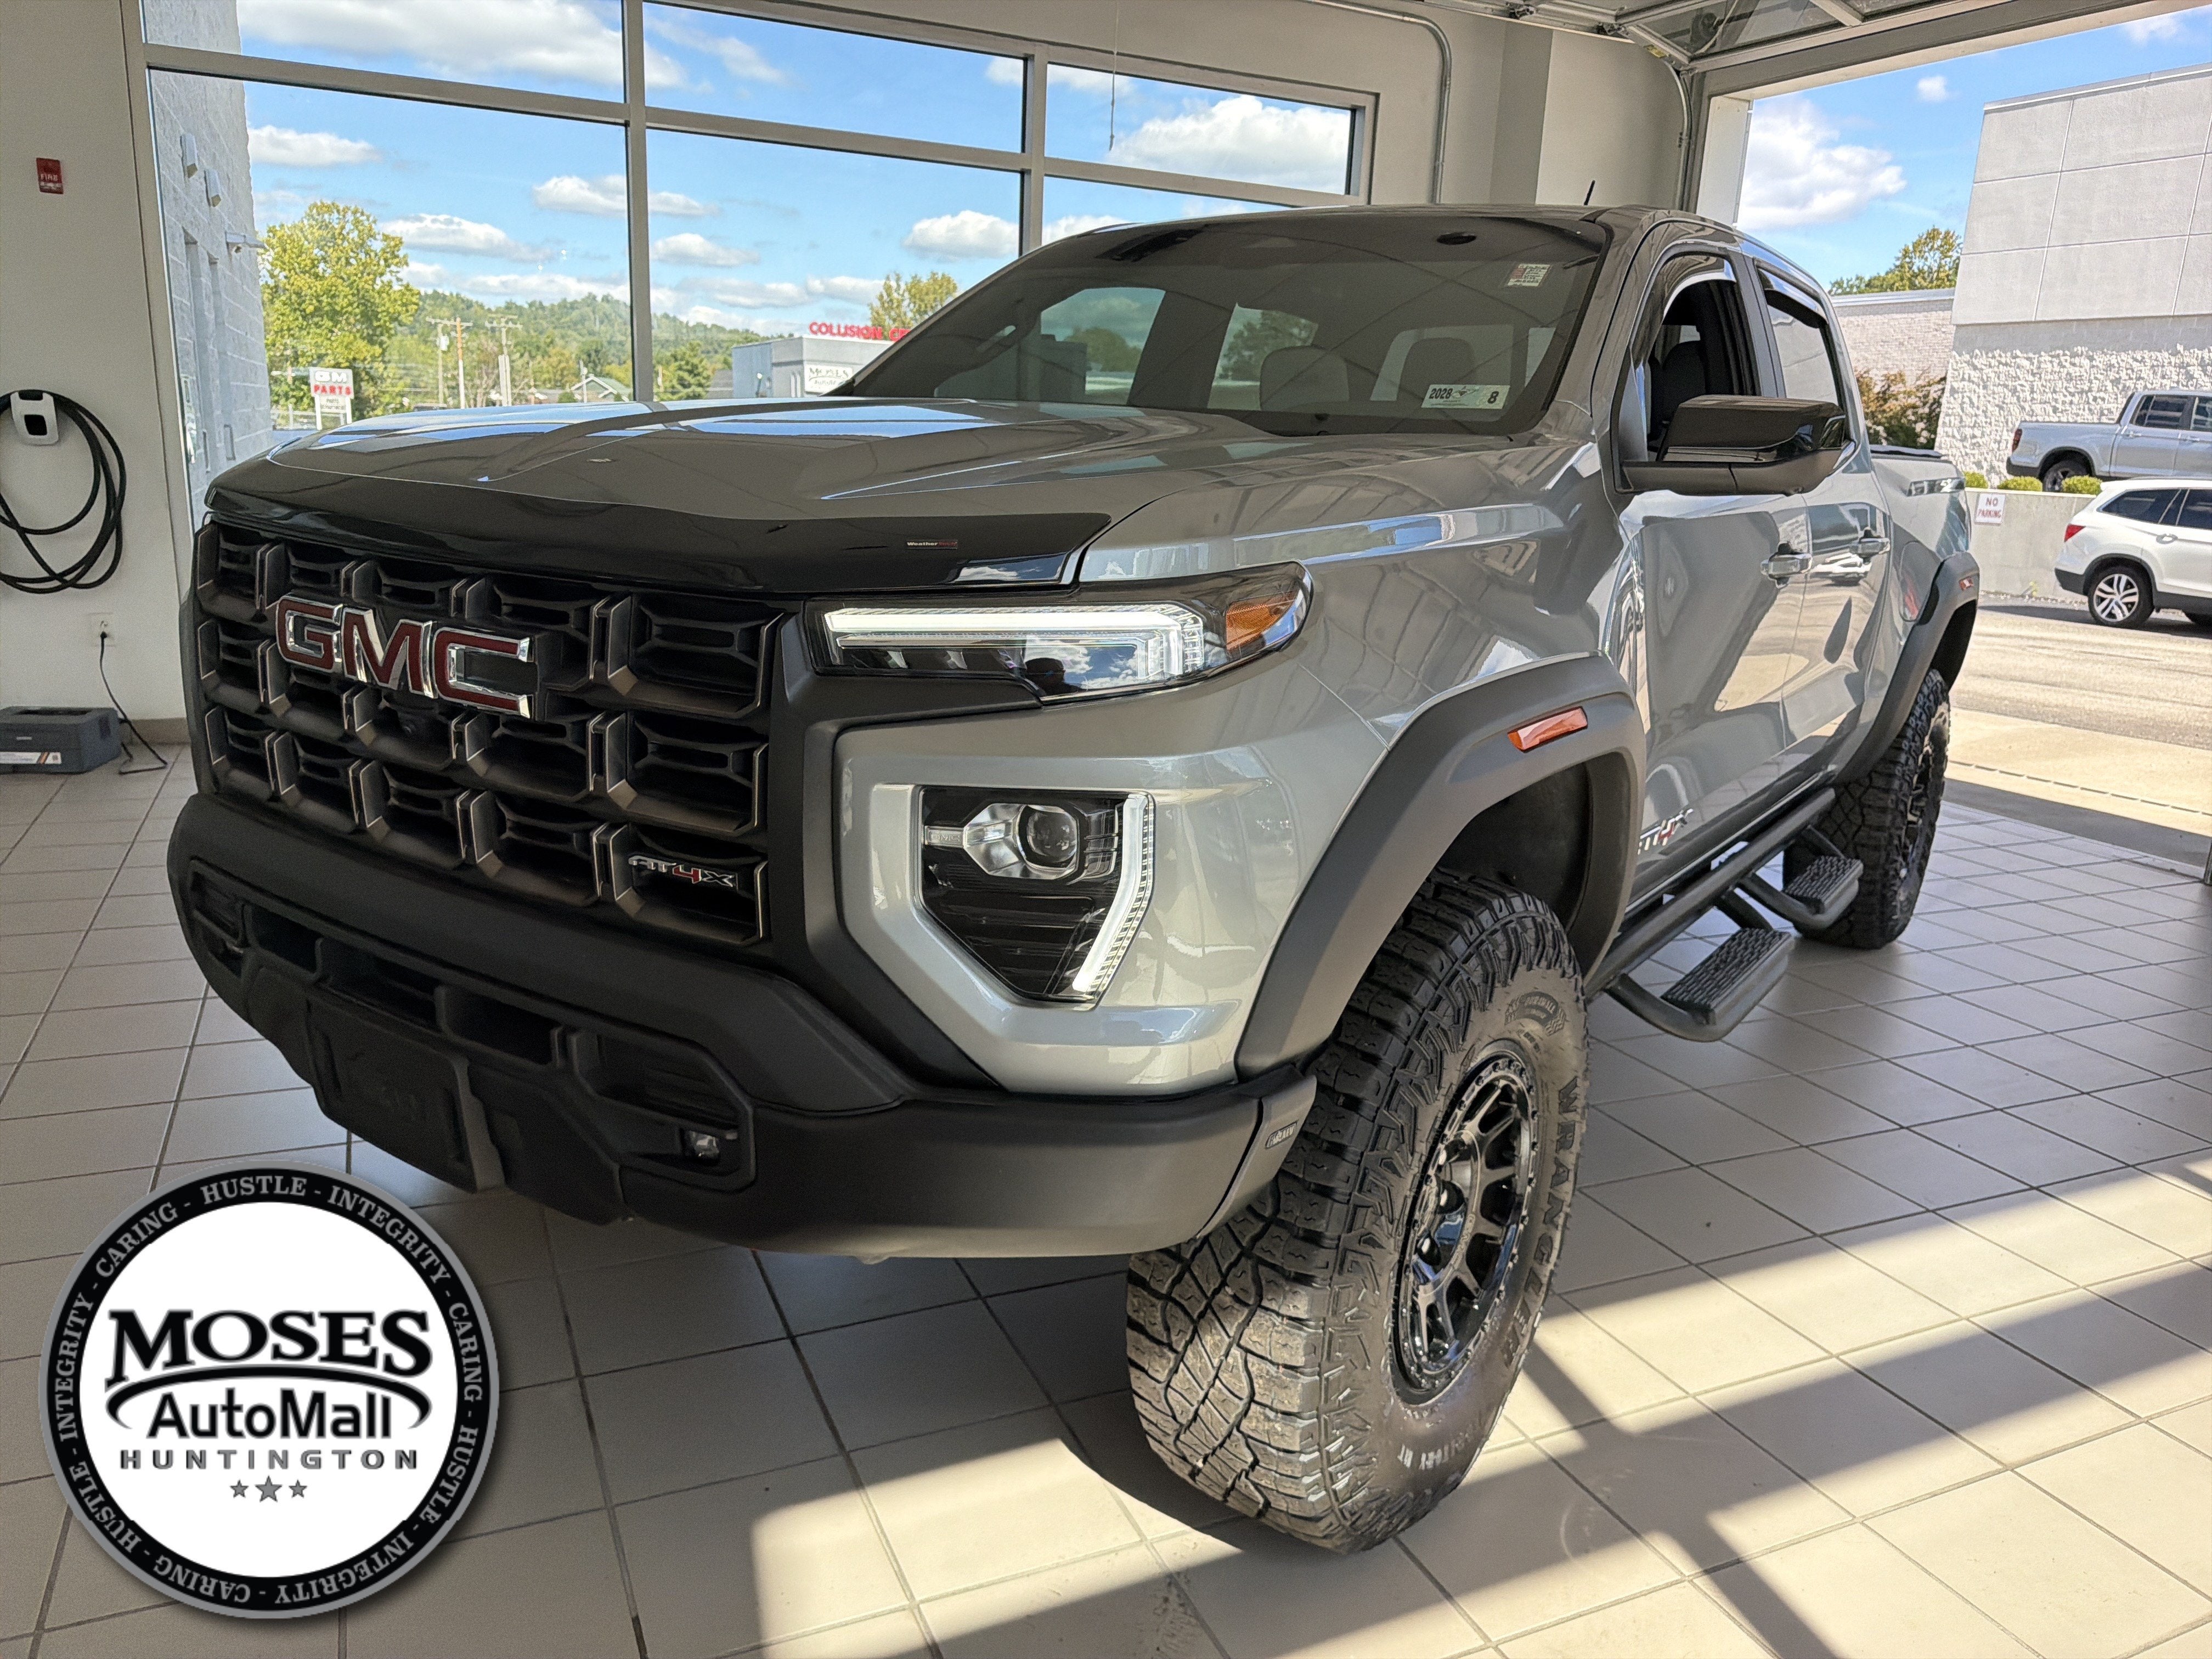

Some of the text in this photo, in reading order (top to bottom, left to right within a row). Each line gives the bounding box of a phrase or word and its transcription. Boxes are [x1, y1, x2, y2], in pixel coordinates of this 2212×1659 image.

[809, 321, 883, 340] COLLISION
[315, 371, 347, 382] GM
[314, 384, 352, 395] PARTS
[1429, 388, 1499, 404] 2028 8
[1985, 497, 1998, 507] NO
[1977, 509, 2001, 518] PARKING
[276, 595, 531, 719] GMC
[629, 855, 734, 888] AT4X
[1500, 1075, 1579, 1369] WRANGLER
